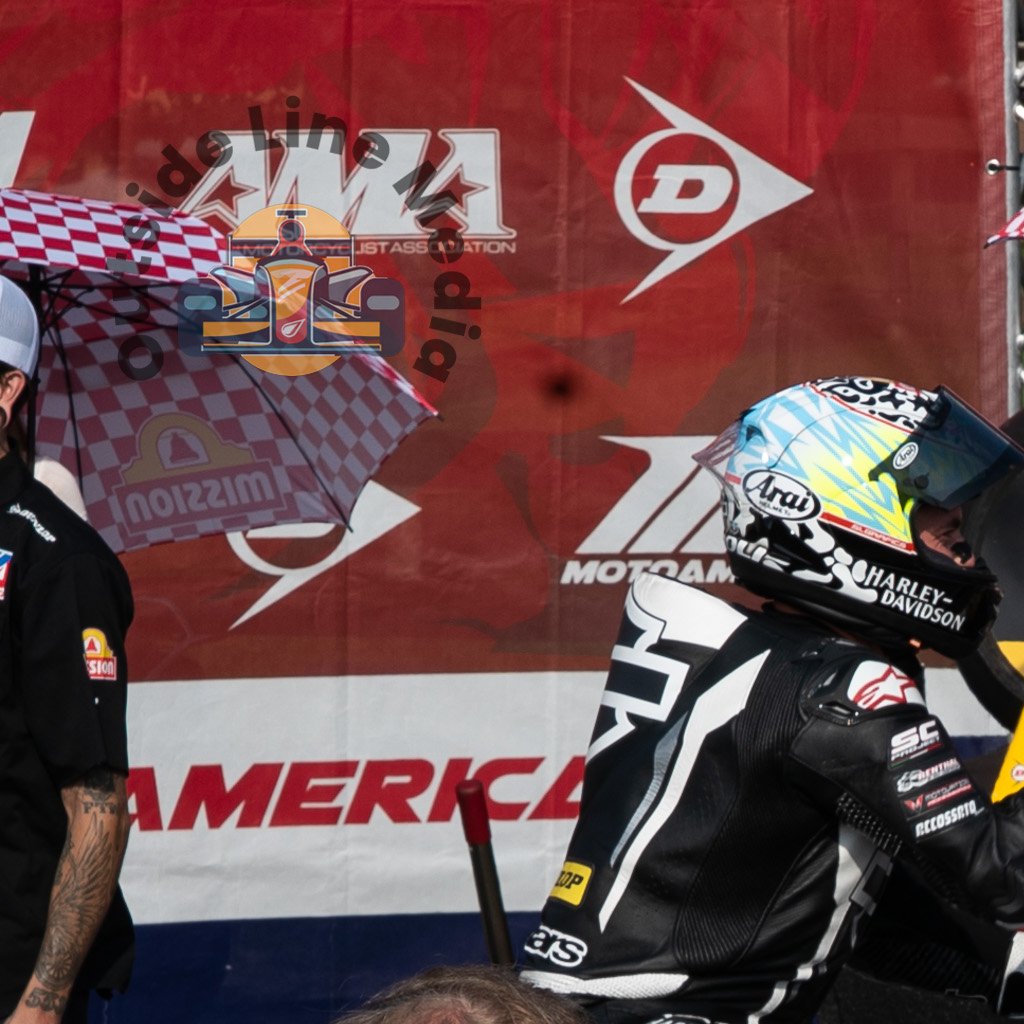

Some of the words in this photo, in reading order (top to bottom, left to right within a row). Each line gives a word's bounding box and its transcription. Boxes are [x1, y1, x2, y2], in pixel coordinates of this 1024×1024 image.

[178, 129, 517, 238] AMA
[388, 241, 516, 255] ASSOCIATION
[745, 475, 810, 512] Arai
[880, 592, 965, 632] DAVIDSON
